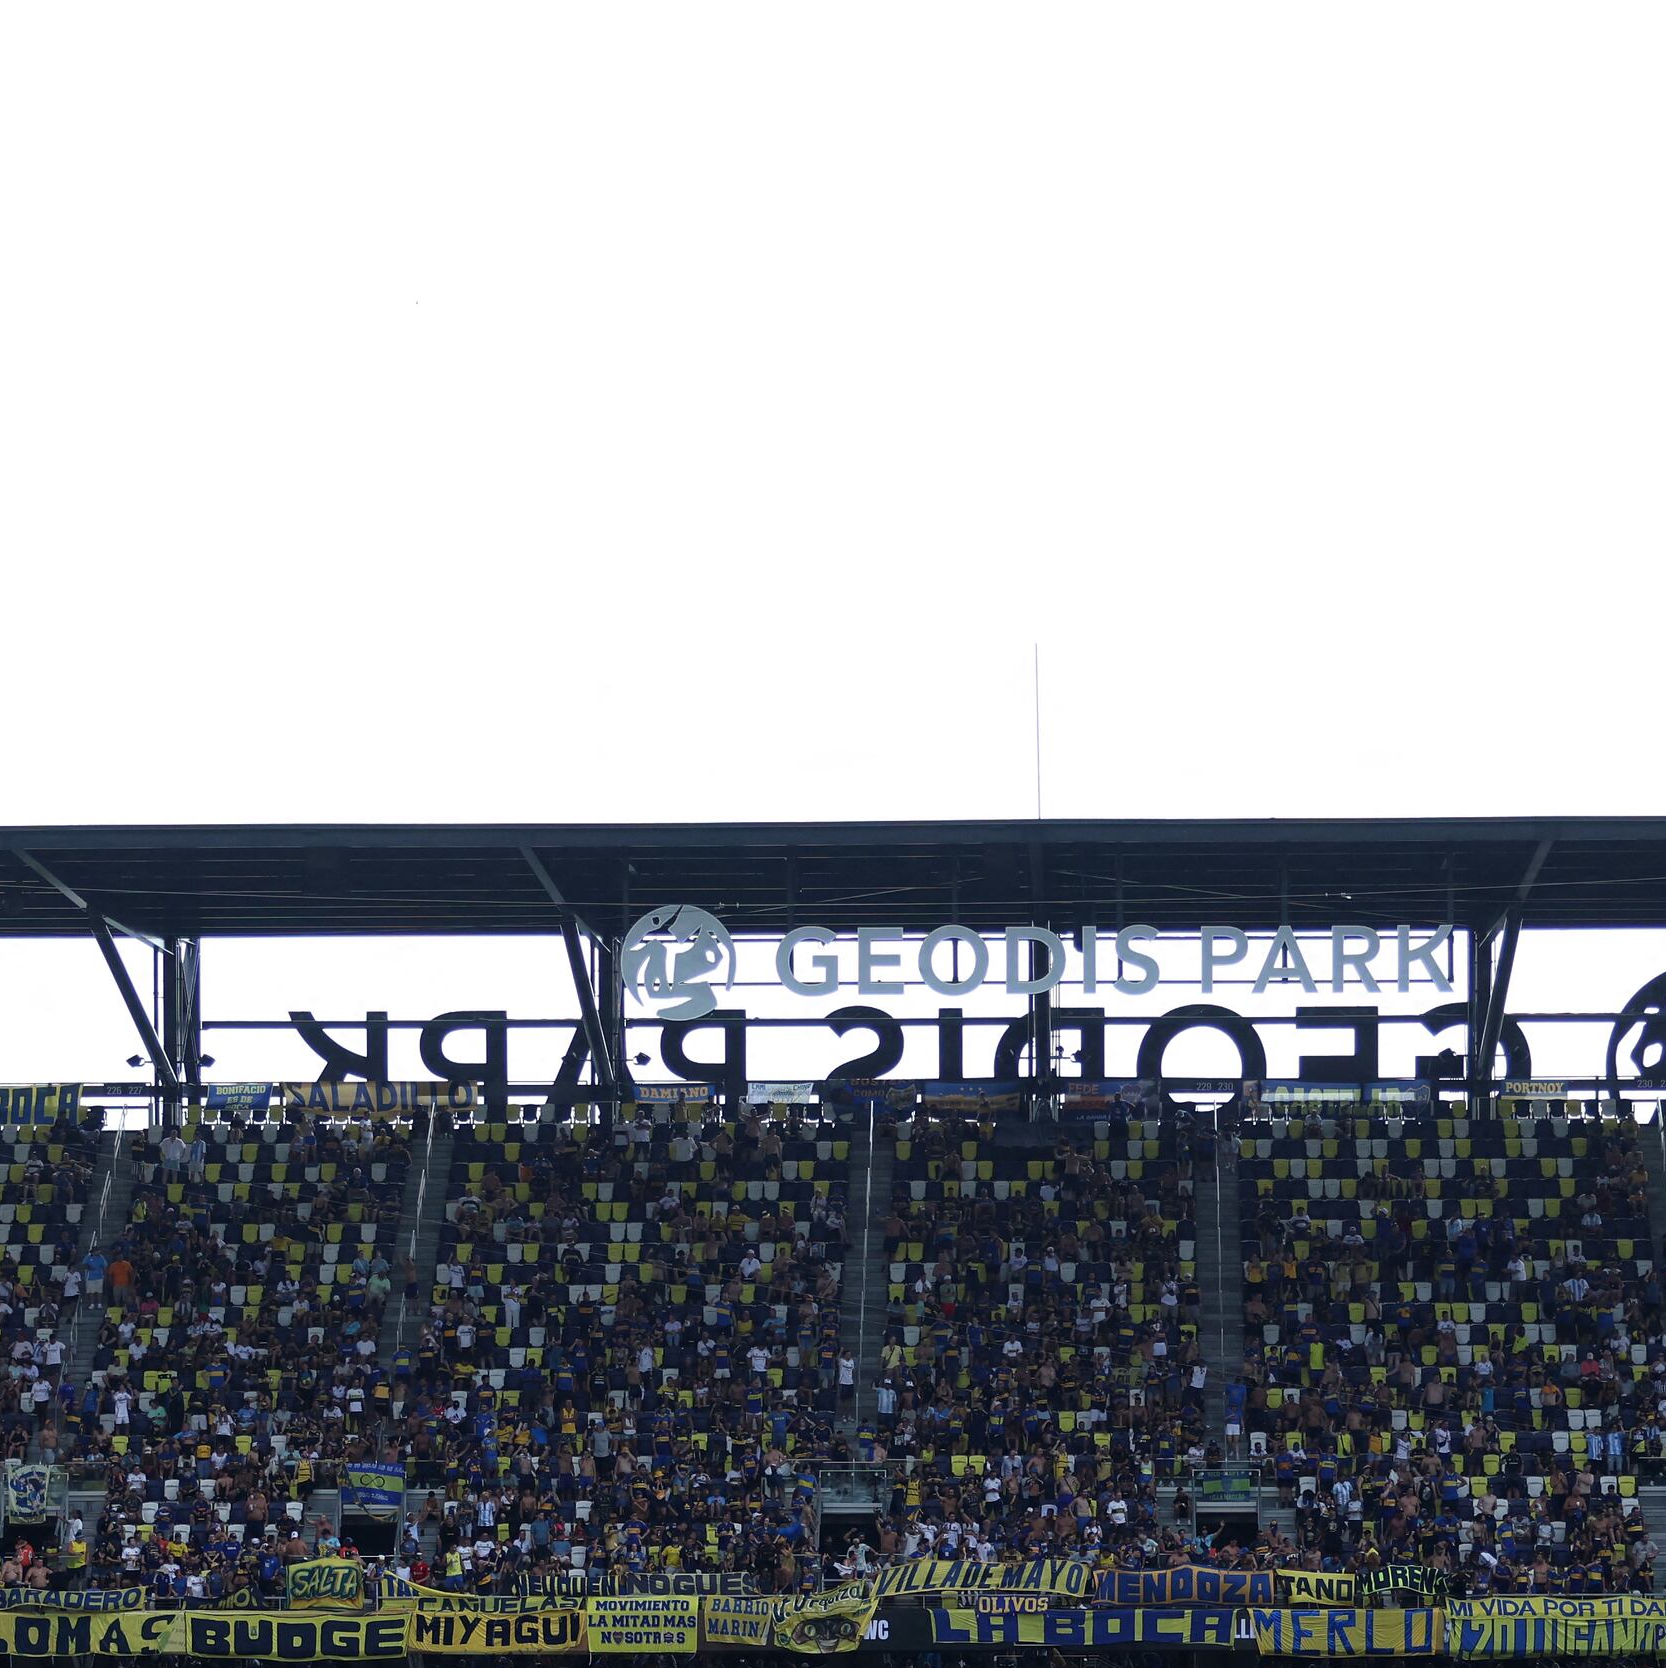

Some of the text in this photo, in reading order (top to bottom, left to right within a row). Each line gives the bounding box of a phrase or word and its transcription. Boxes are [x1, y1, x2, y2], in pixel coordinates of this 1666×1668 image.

[774, 924, 1454, 996] GEODIS PARK
[216, 1085, 266, 1095] BONIFACIO
[1505, 1082, 1565, 1095] PORTNOY
[1637, 1079, 1653, 1088] 230
[285, 1081, 474, 1113] SALADILLO
[292, 1564, 361, 1600] SALTA
[627, 1574, 756, 1596] NOGUES
[877, 1559, 1084, 1596] VILLA DE MAYO
[1096, 1570, 1272, 1602] MENDOZA
[1283, 1576, 1353, 1600] TANO
[595, 1599, 689, 1612] MOVIMIENTO
[711, 1599, 769, 1616] BARRIO
[978, 1597, 1049, 1614] OLIVOS
[1449, 1599, 1473, 1617] MI
[1478, 1599, 1535, 1617] VIDA
[1547, 1599, 1595, 1617] POR
[1602, 1599, 1623, 1617] TI
[416, 1612, 579, 1647] MIYAGUI
[588, 1614, 696, 1628] LA MITAD MAS
[933, 1609, 1009, 1643] LA
[1044, 1609, 1231, 1643] BOCA
[1255, 1609, 1433, 1655] MERLO
[191, 1617, 405, 1657] BUDGE
